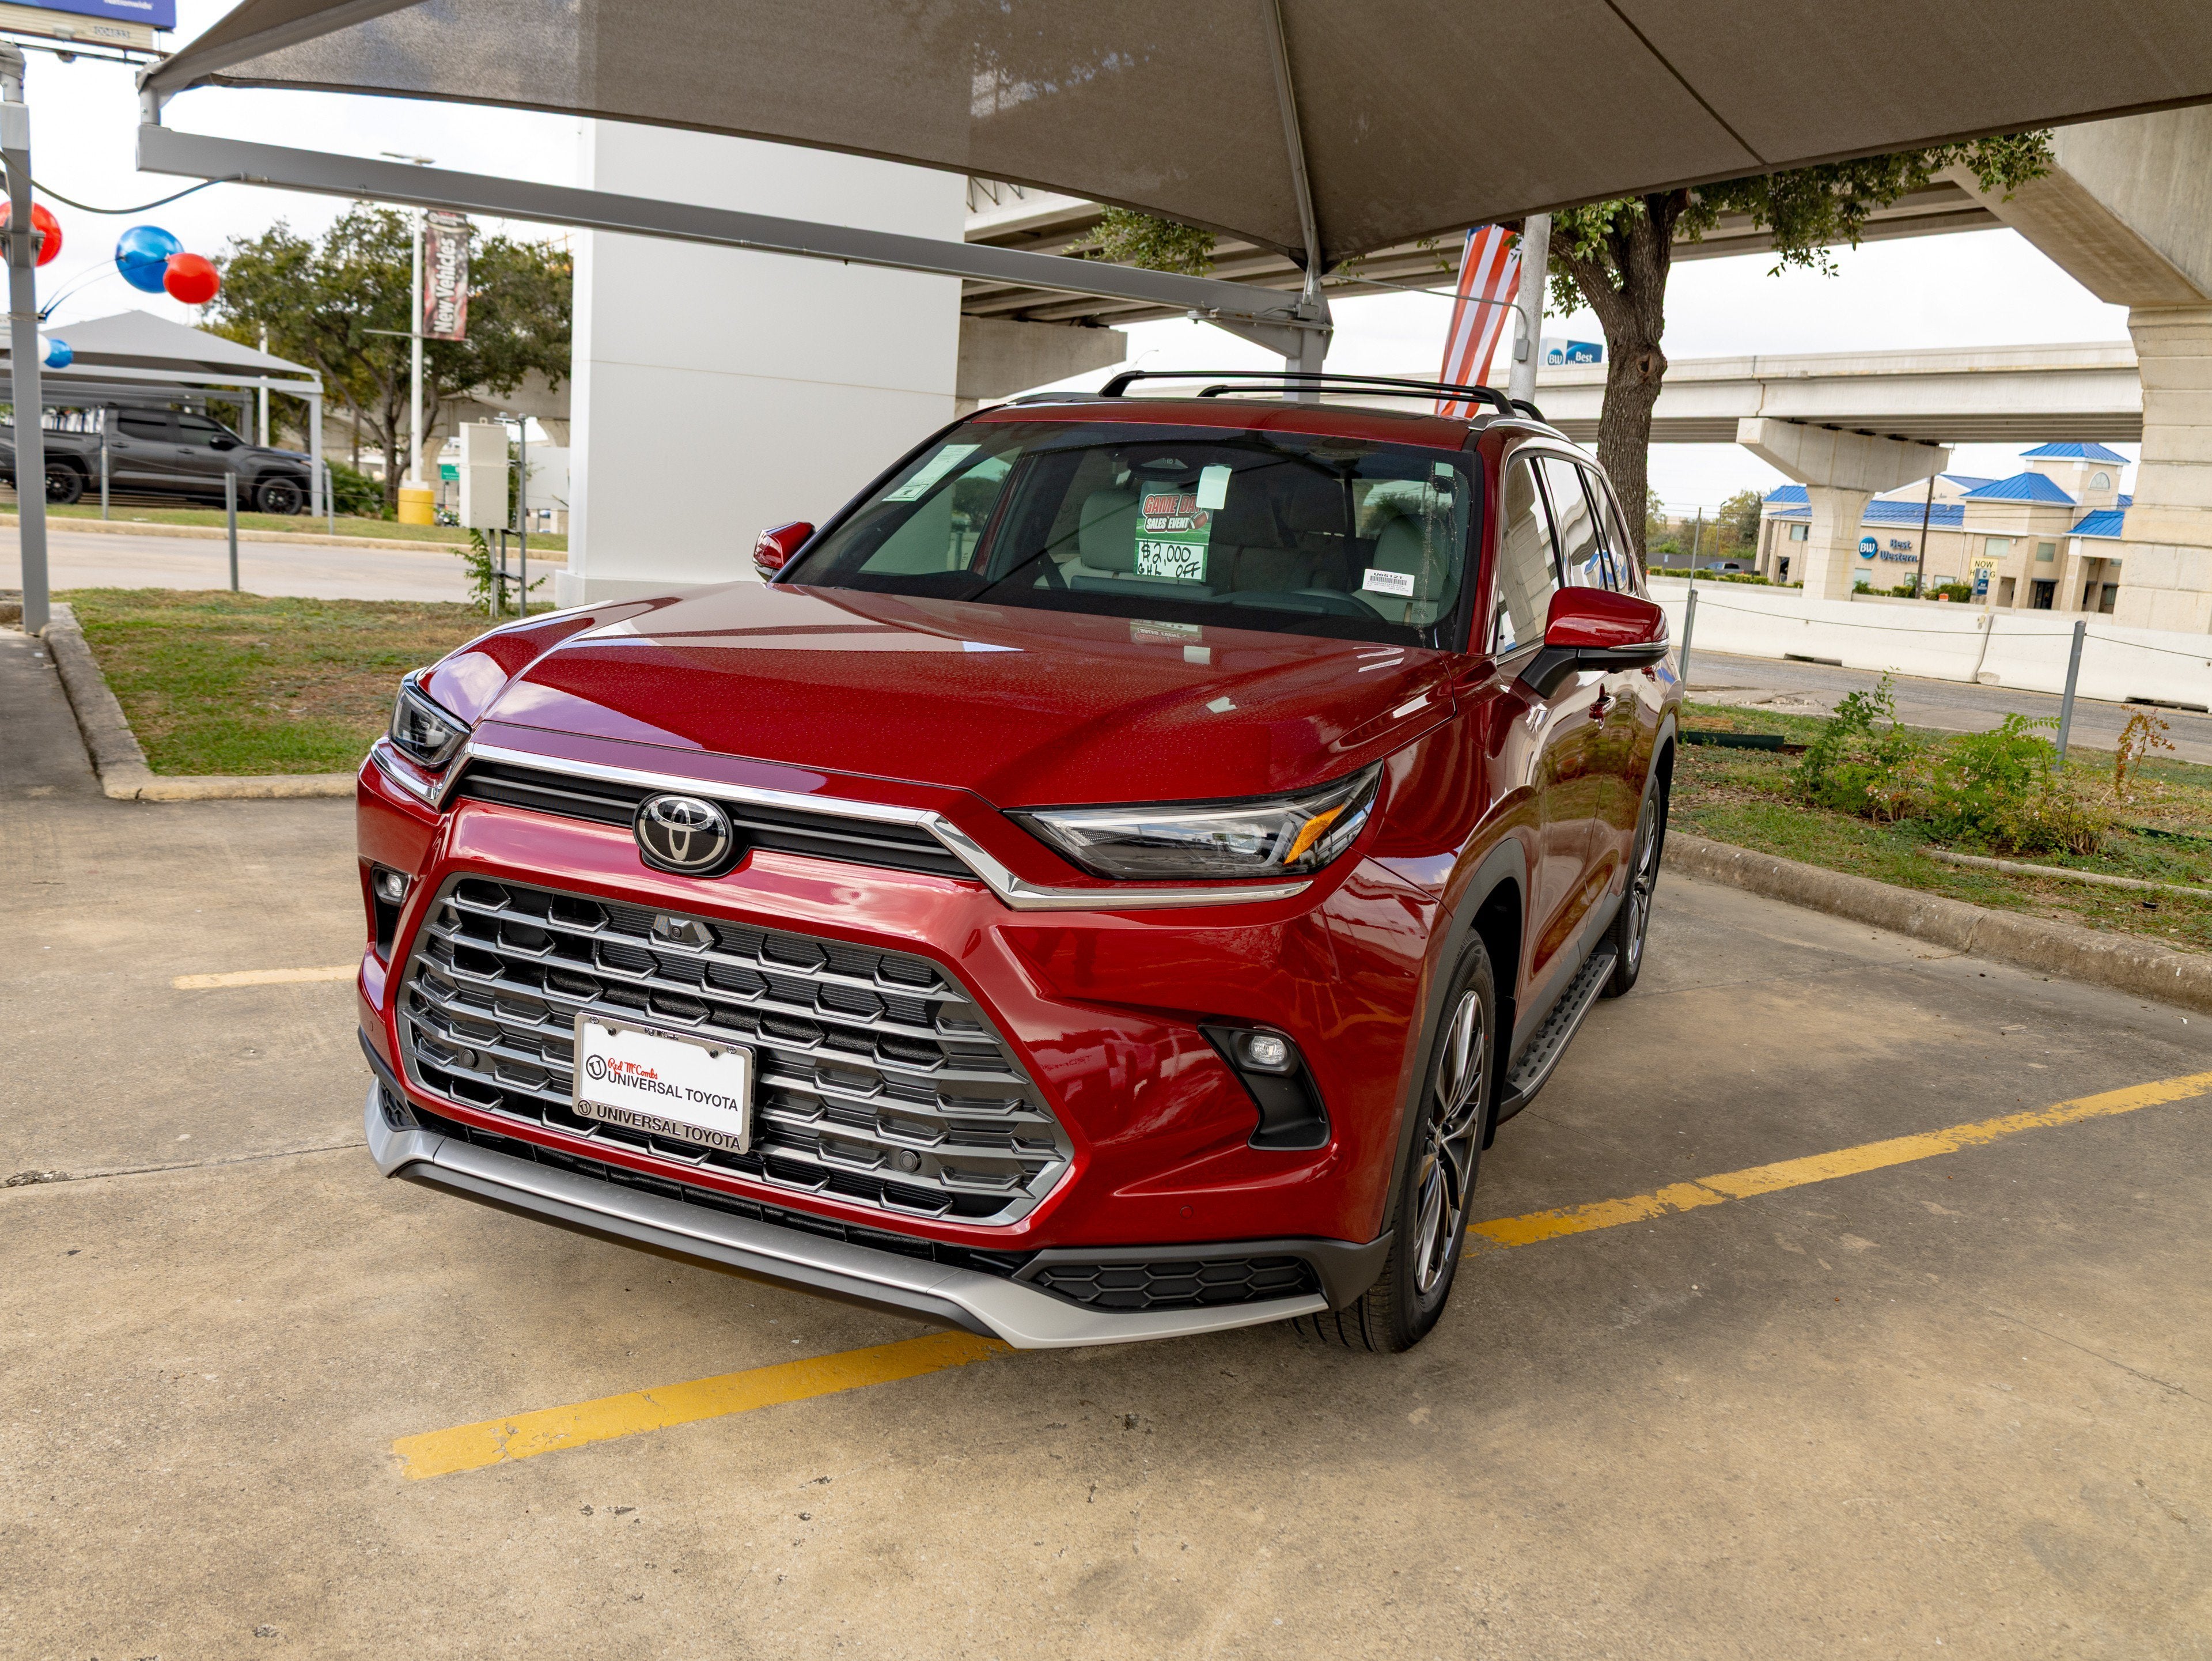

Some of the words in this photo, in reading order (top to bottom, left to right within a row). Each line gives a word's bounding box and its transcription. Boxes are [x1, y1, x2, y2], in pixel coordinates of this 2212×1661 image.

[436, 237, 456, 298] Vehicles
[434, 299, 454, 333] New
[1549, 354, 1562, 364] BW
[1575, 351, 1592, 362] Best
[1144, 496, 1179, 513] GAME
[1179, 495, 1199, 513] DA
[1146, 518, 1167, 529] SALES
[1168, 518, 1189, 529] EVENT
[1141, 539, 1191, 566] $2,000
[1860, 543, 1875, 553] BW
[1890, 539, 1911, 549] Best
[1880, 551, 1917, 562] Western
[608, 1058, 623, 1074] Red
[624, 1061, 658, 1080] McCombs
[608, 1070, 683, 1099] UNIVERSAL
[685, 1088, 738, 1111] TOYOTA
[597, 1103, 681, 1135] UNIVERSAL
[683, 1123, 741, 1151] TOYOTA
